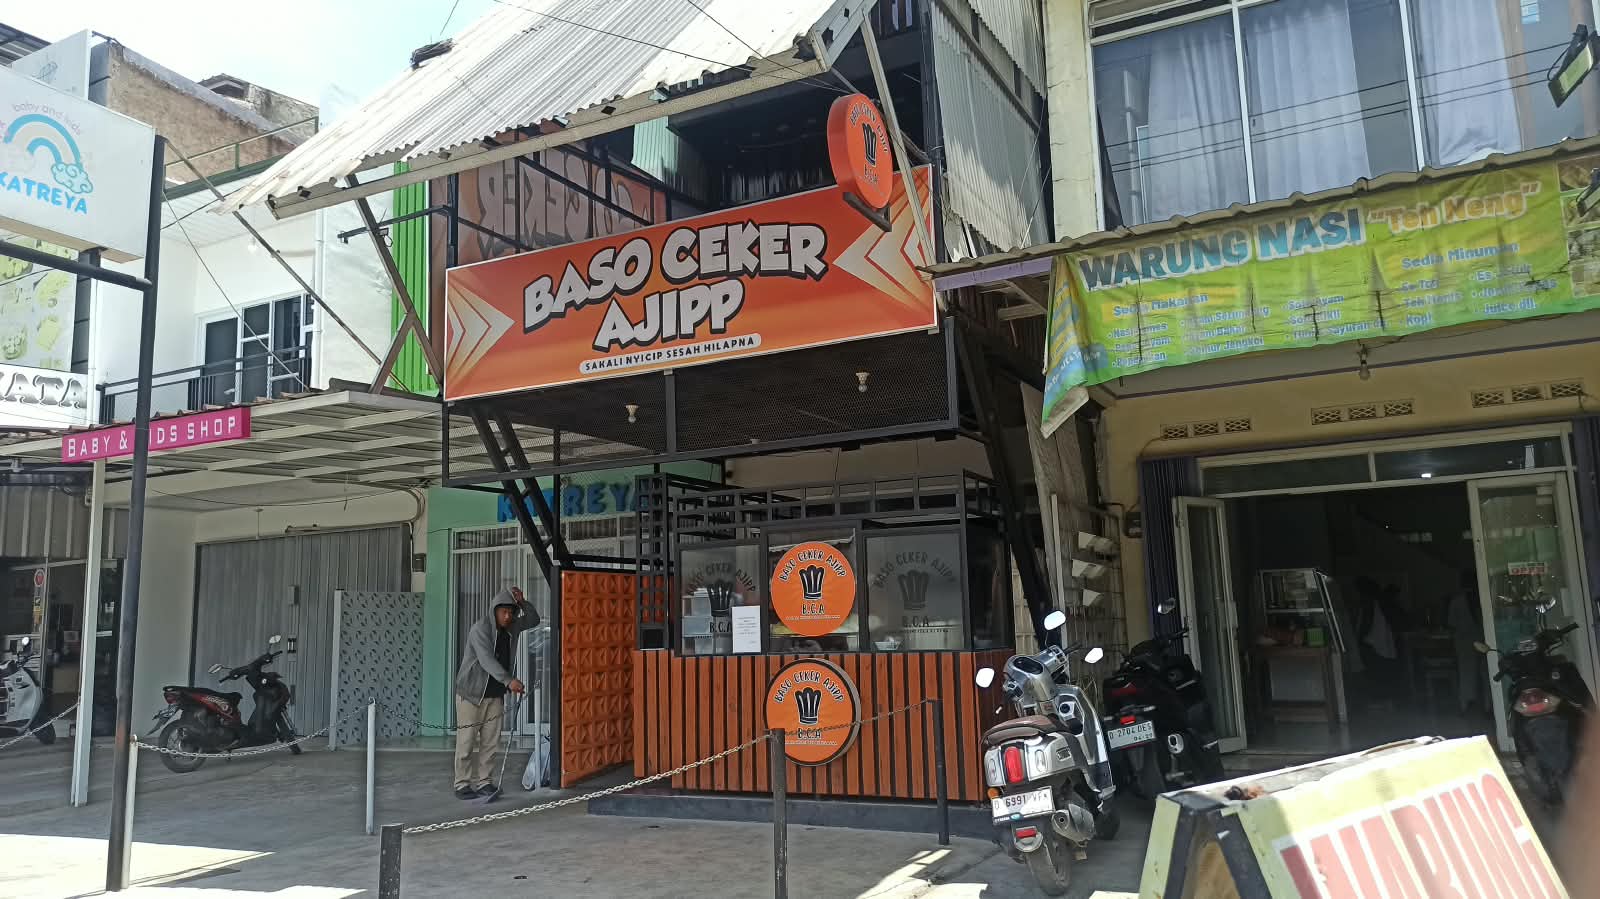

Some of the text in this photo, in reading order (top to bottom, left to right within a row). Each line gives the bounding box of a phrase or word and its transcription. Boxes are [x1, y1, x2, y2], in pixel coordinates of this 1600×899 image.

[13, 102, 39, 113] baby
[42, 104, 63, 119] and
[0, 171, 87, 215] KATREYA
[1079, 229, 1250, 290] WARUNG
[1257, 206, 1363, 259] NASI
[1402, 255, 1444, 269] Sedia
[524, 221, 828, 333] BASO CEKER
[593, 278, 744, 352] AJIPP
[585, 337, 754, 371] SAKALI NYICIP SESAH HILAPNA
[0, 372, 87, 409] ATA
[68, 435, 111, 458] BABY
[119, 430, 128, 450] &
[187, 415, 236, 440] SHOP
[779, 548, 847, 582] BASO CEKER AJIPP
[802, 603, 825, 615] B.C.A
[774, 670, 845, 704] BASO CEKER AJIPP
[1005, 795, 1026, 808] 6991
